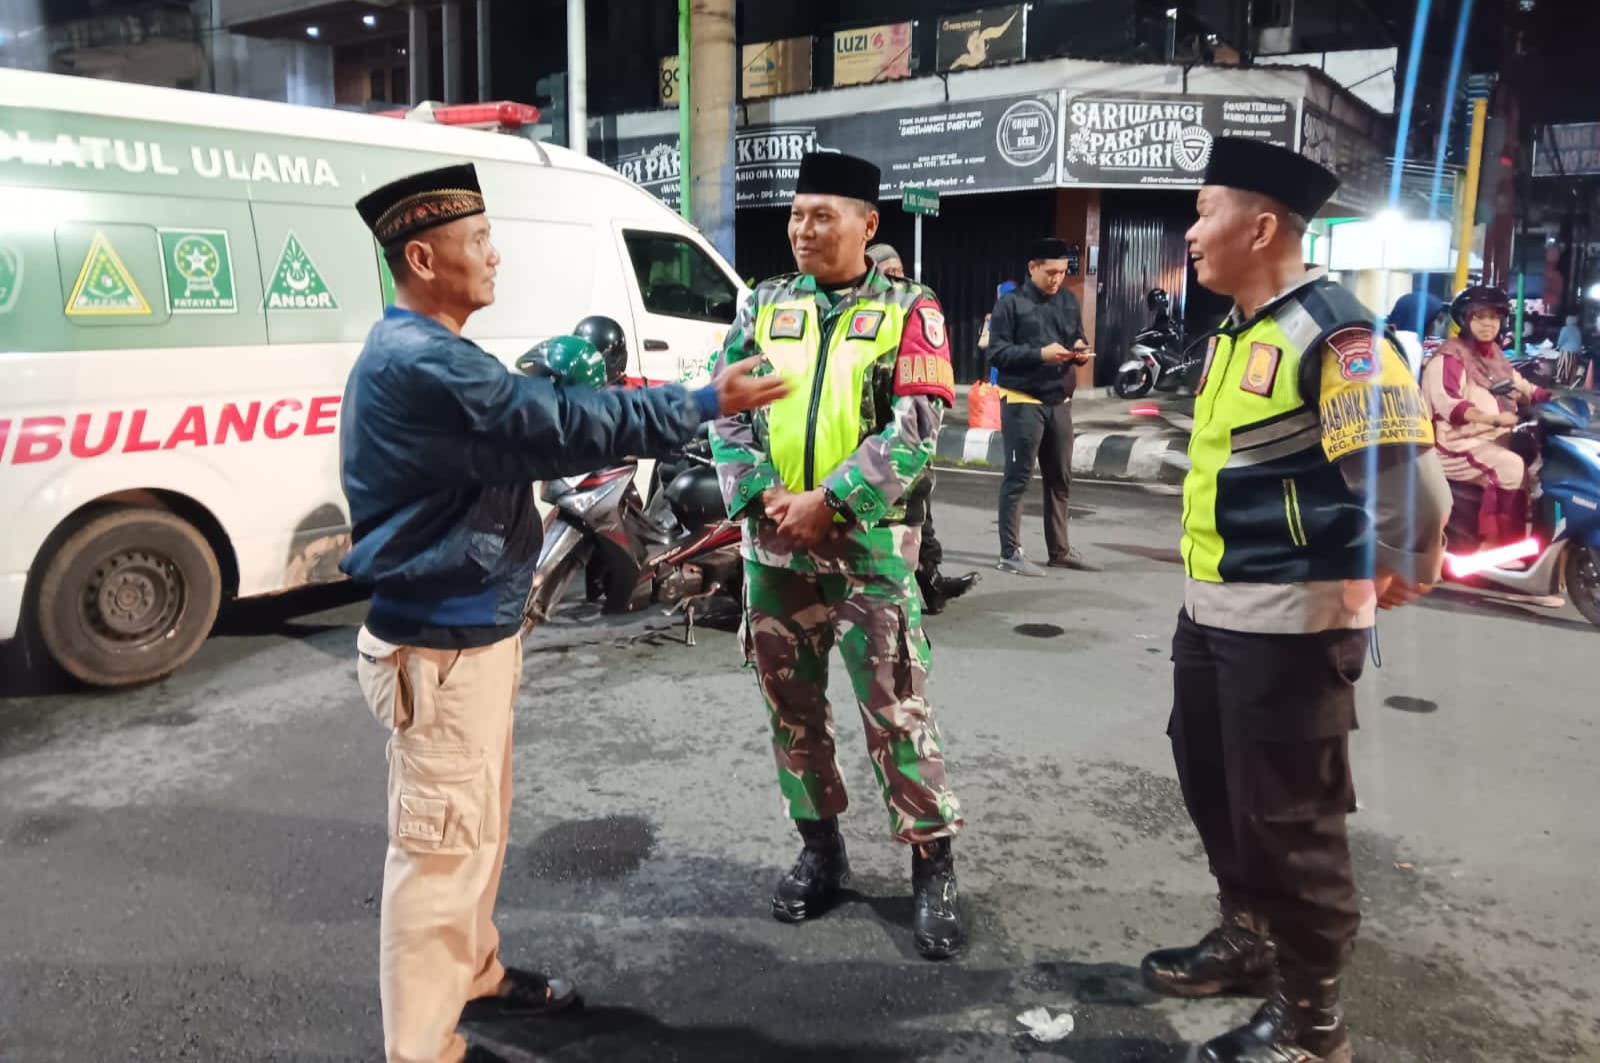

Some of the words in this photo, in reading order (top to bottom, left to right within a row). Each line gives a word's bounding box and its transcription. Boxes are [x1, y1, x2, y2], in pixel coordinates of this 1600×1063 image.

[837, 34, 868, 53] LUZI
[1070, 102, 1204, 129] SARIWANGI
[1090, 121, 1182, 152] PARFUM
[191, 146, 339, 186] ULAMA
[1100, 143, 1173, 168] KEDIRI
[269, 292, 333, 307] ANSOR
